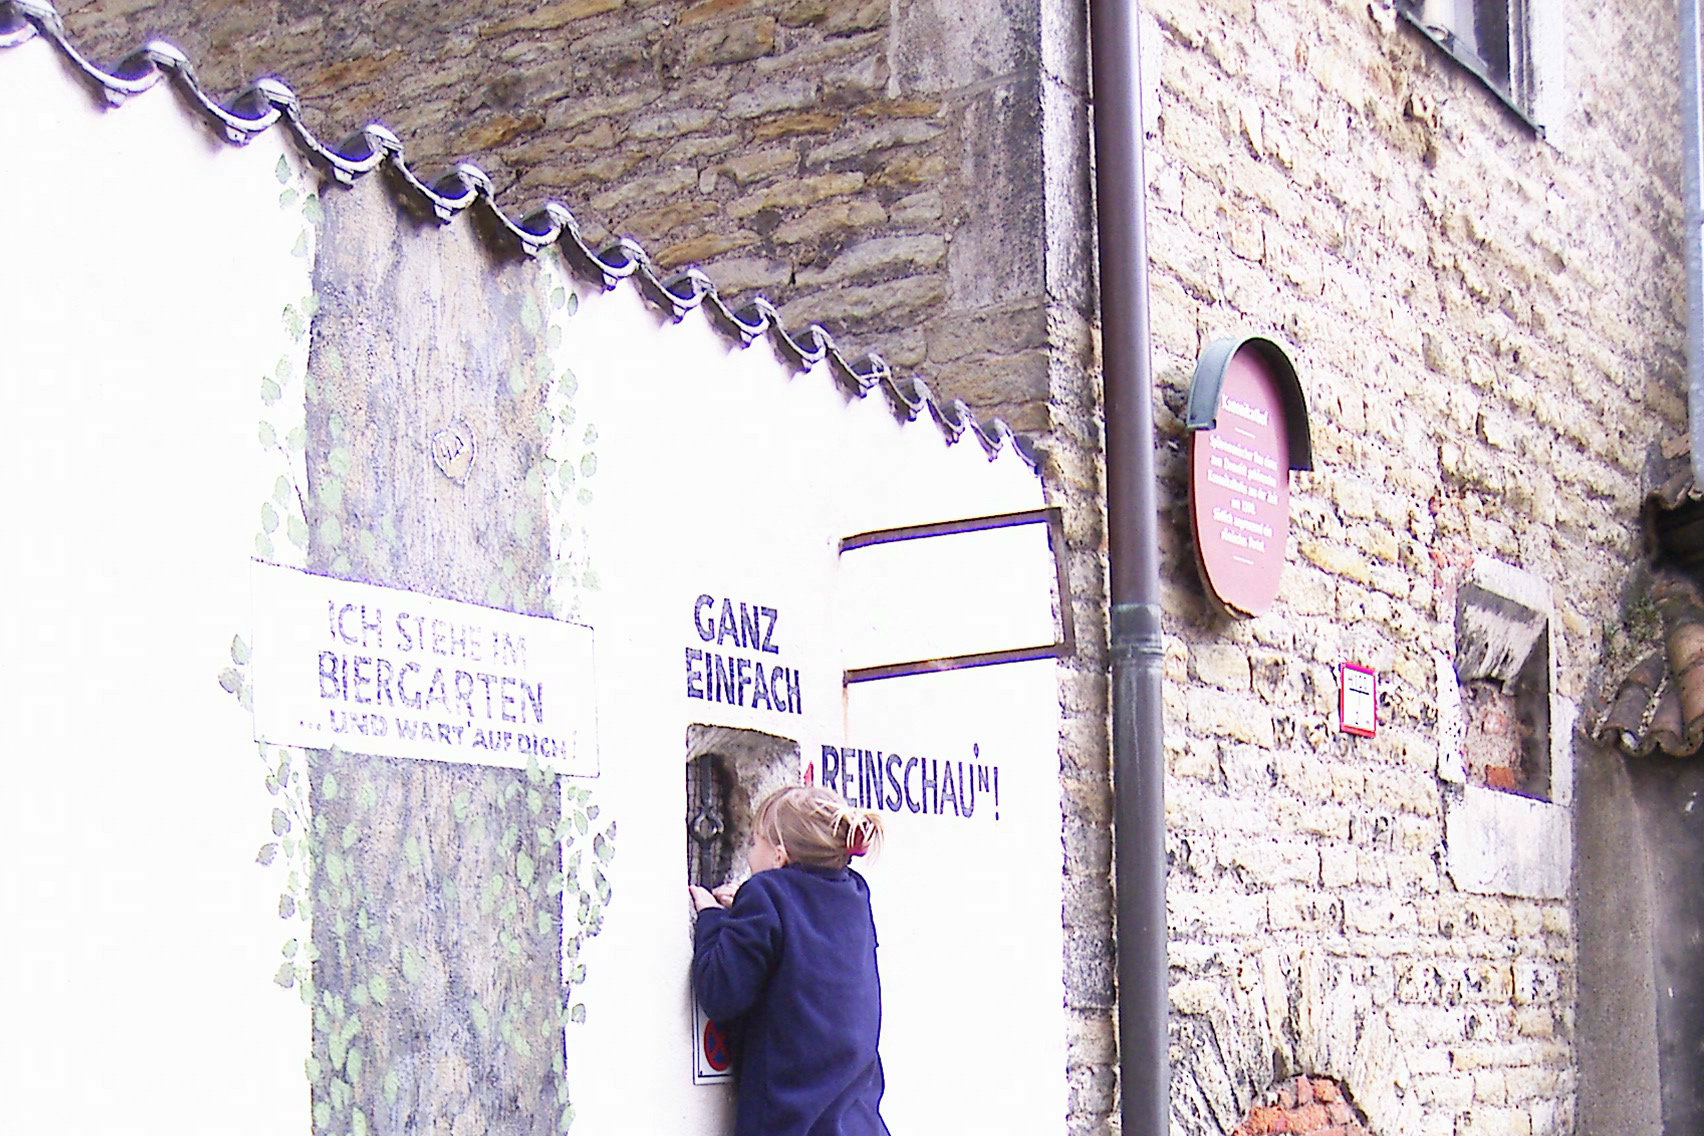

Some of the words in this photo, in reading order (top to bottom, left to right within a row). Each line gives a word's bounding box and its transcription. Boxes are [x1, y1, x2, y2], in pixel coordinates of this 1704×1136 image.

[328, 600, 383, 648] ICH
[396, 611, 481, 661] STEHE
[492, 631, 527, 669] IM
[694, 594, 779, 654] GANZ
[318, 650, 544, 724] BIERGARTEN
[686, 647, 802, 714] EINFACH
[472, 728, 512, 751] AUF
